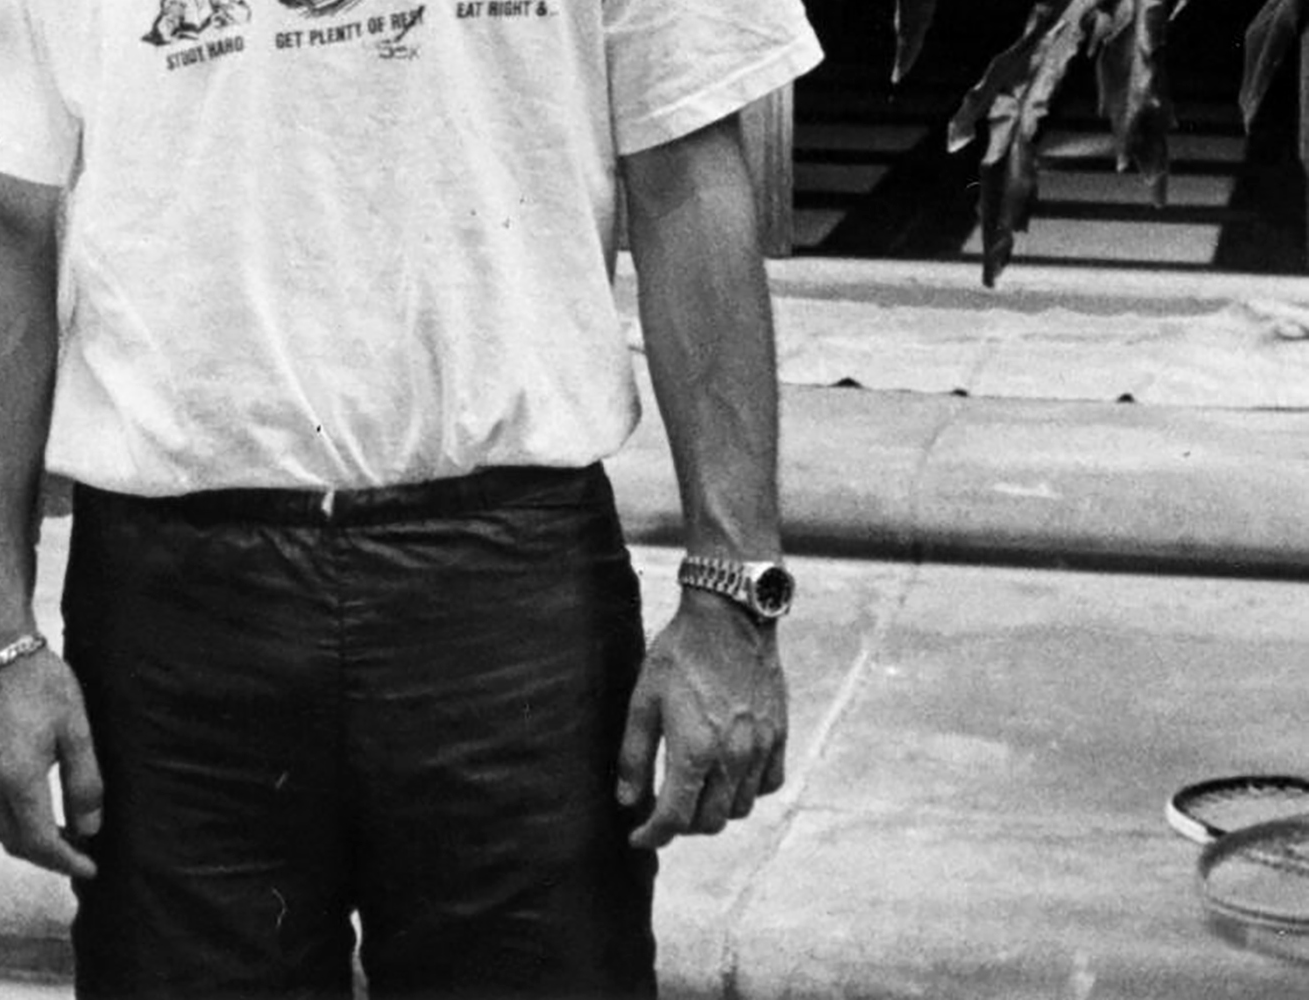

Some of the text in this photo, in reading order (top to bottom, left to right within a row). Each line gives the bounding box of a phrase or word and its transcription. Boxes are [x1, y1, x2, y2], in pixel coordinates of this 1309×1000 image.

[456, 1, 484, 19] EAT
[487, 0, 533, 17] RIGHT
[275, 31, 303, 49] GET
[309, 22, 362, 46] PLENTY
[367, 16, 386, 34] OF
[166, 35, 244, 71] STUDY HARD
